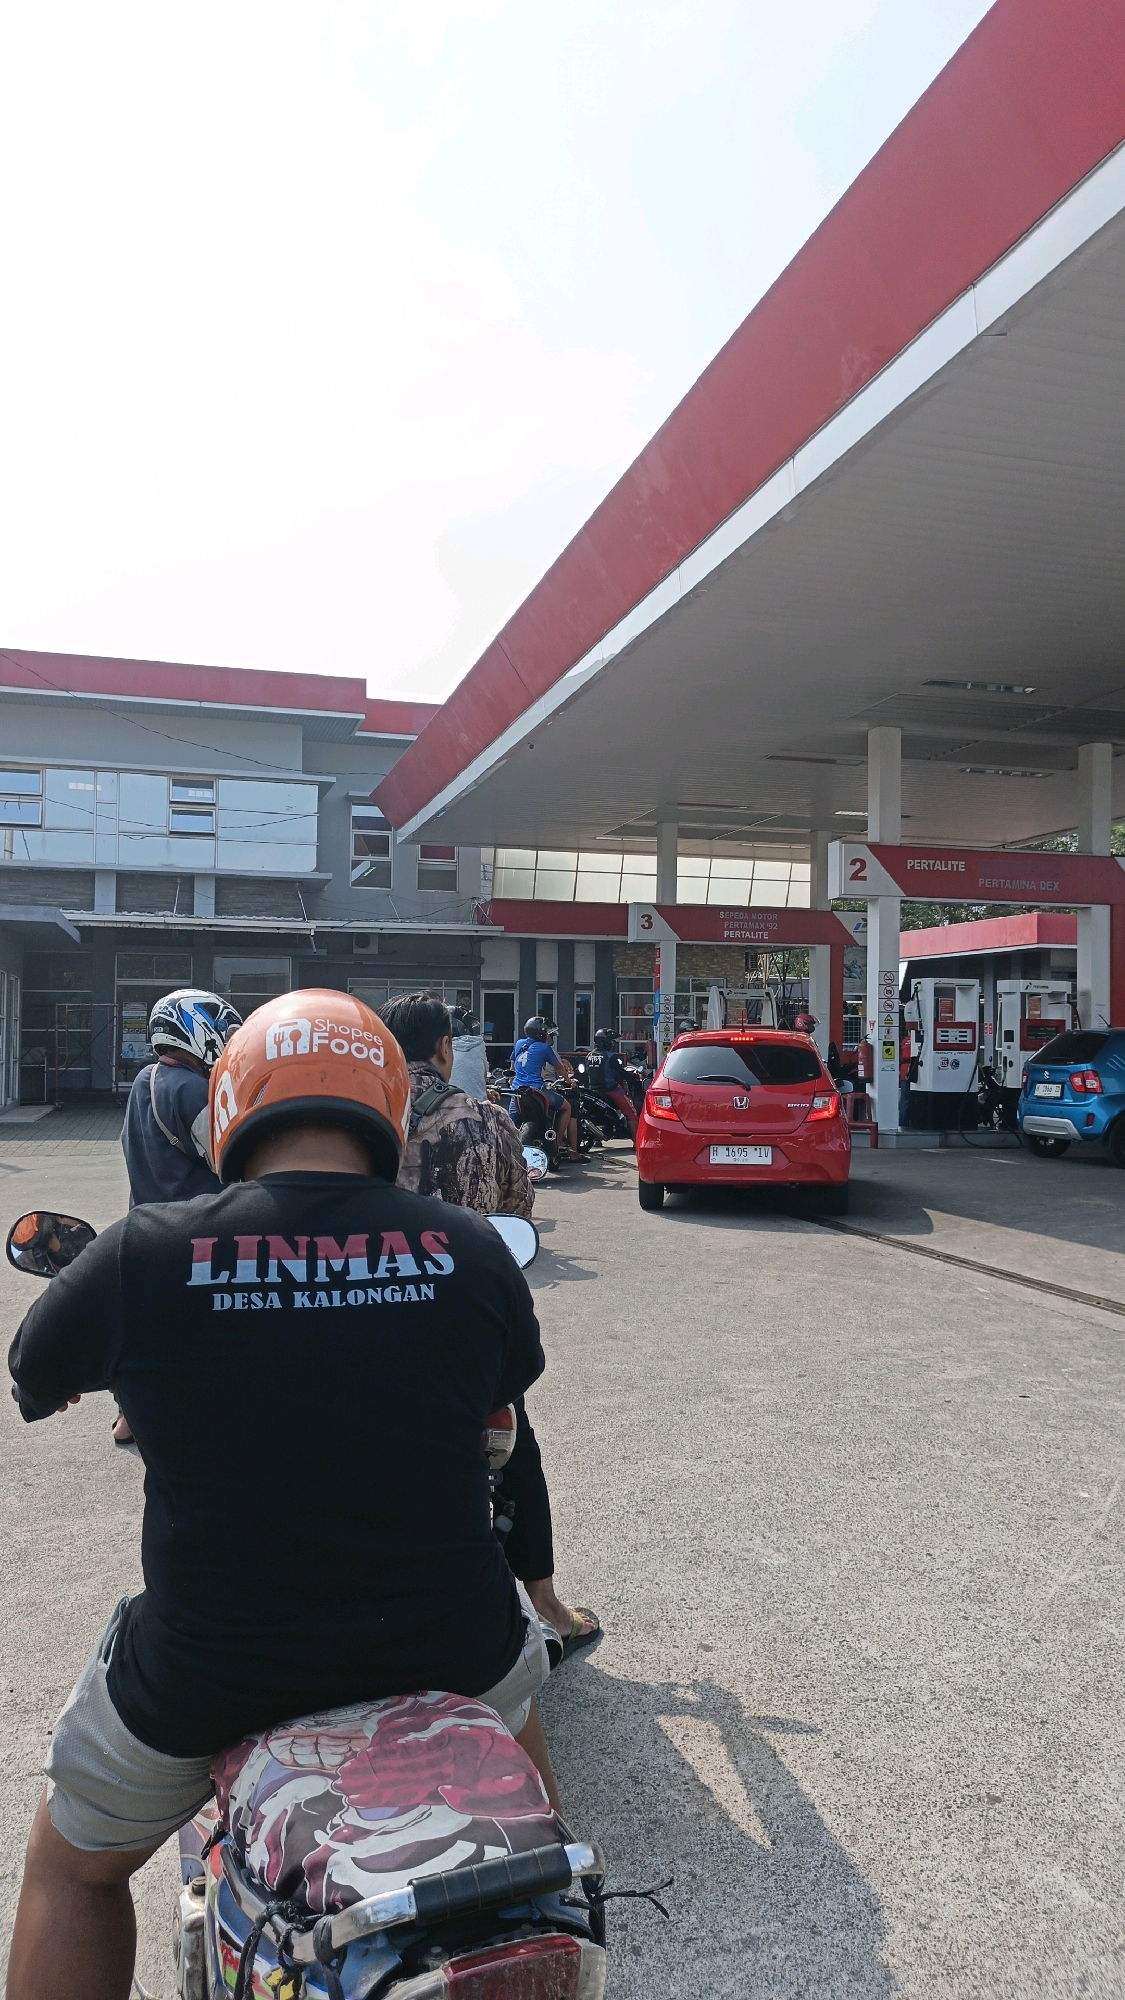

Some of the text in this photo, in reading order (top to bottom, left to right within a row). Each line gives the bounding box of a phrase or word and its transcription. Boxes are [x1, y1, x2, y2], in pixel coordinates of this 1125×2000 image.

[848, 857, 868, 882] 2
[907, 859, 966, 872] PERTALITE
[978, 878, 1060, 891] PERTAMINA DEX
[640, 913, 653, 930] 3
[719, 911, 749, 919] SEPEDA
[724, 921, 765, 930] PERTAMAX
[724, 930, 769, 939] PERTALITE
[313, 1018, 383, 1046] Shopee
[312, 1032, 385, 1068] Food
[712, 1146, 718, 1157] H
[186, 1230, 455, 1286] LINMAS
[211, 1283, 436, 1311] DESA KALONGAN
